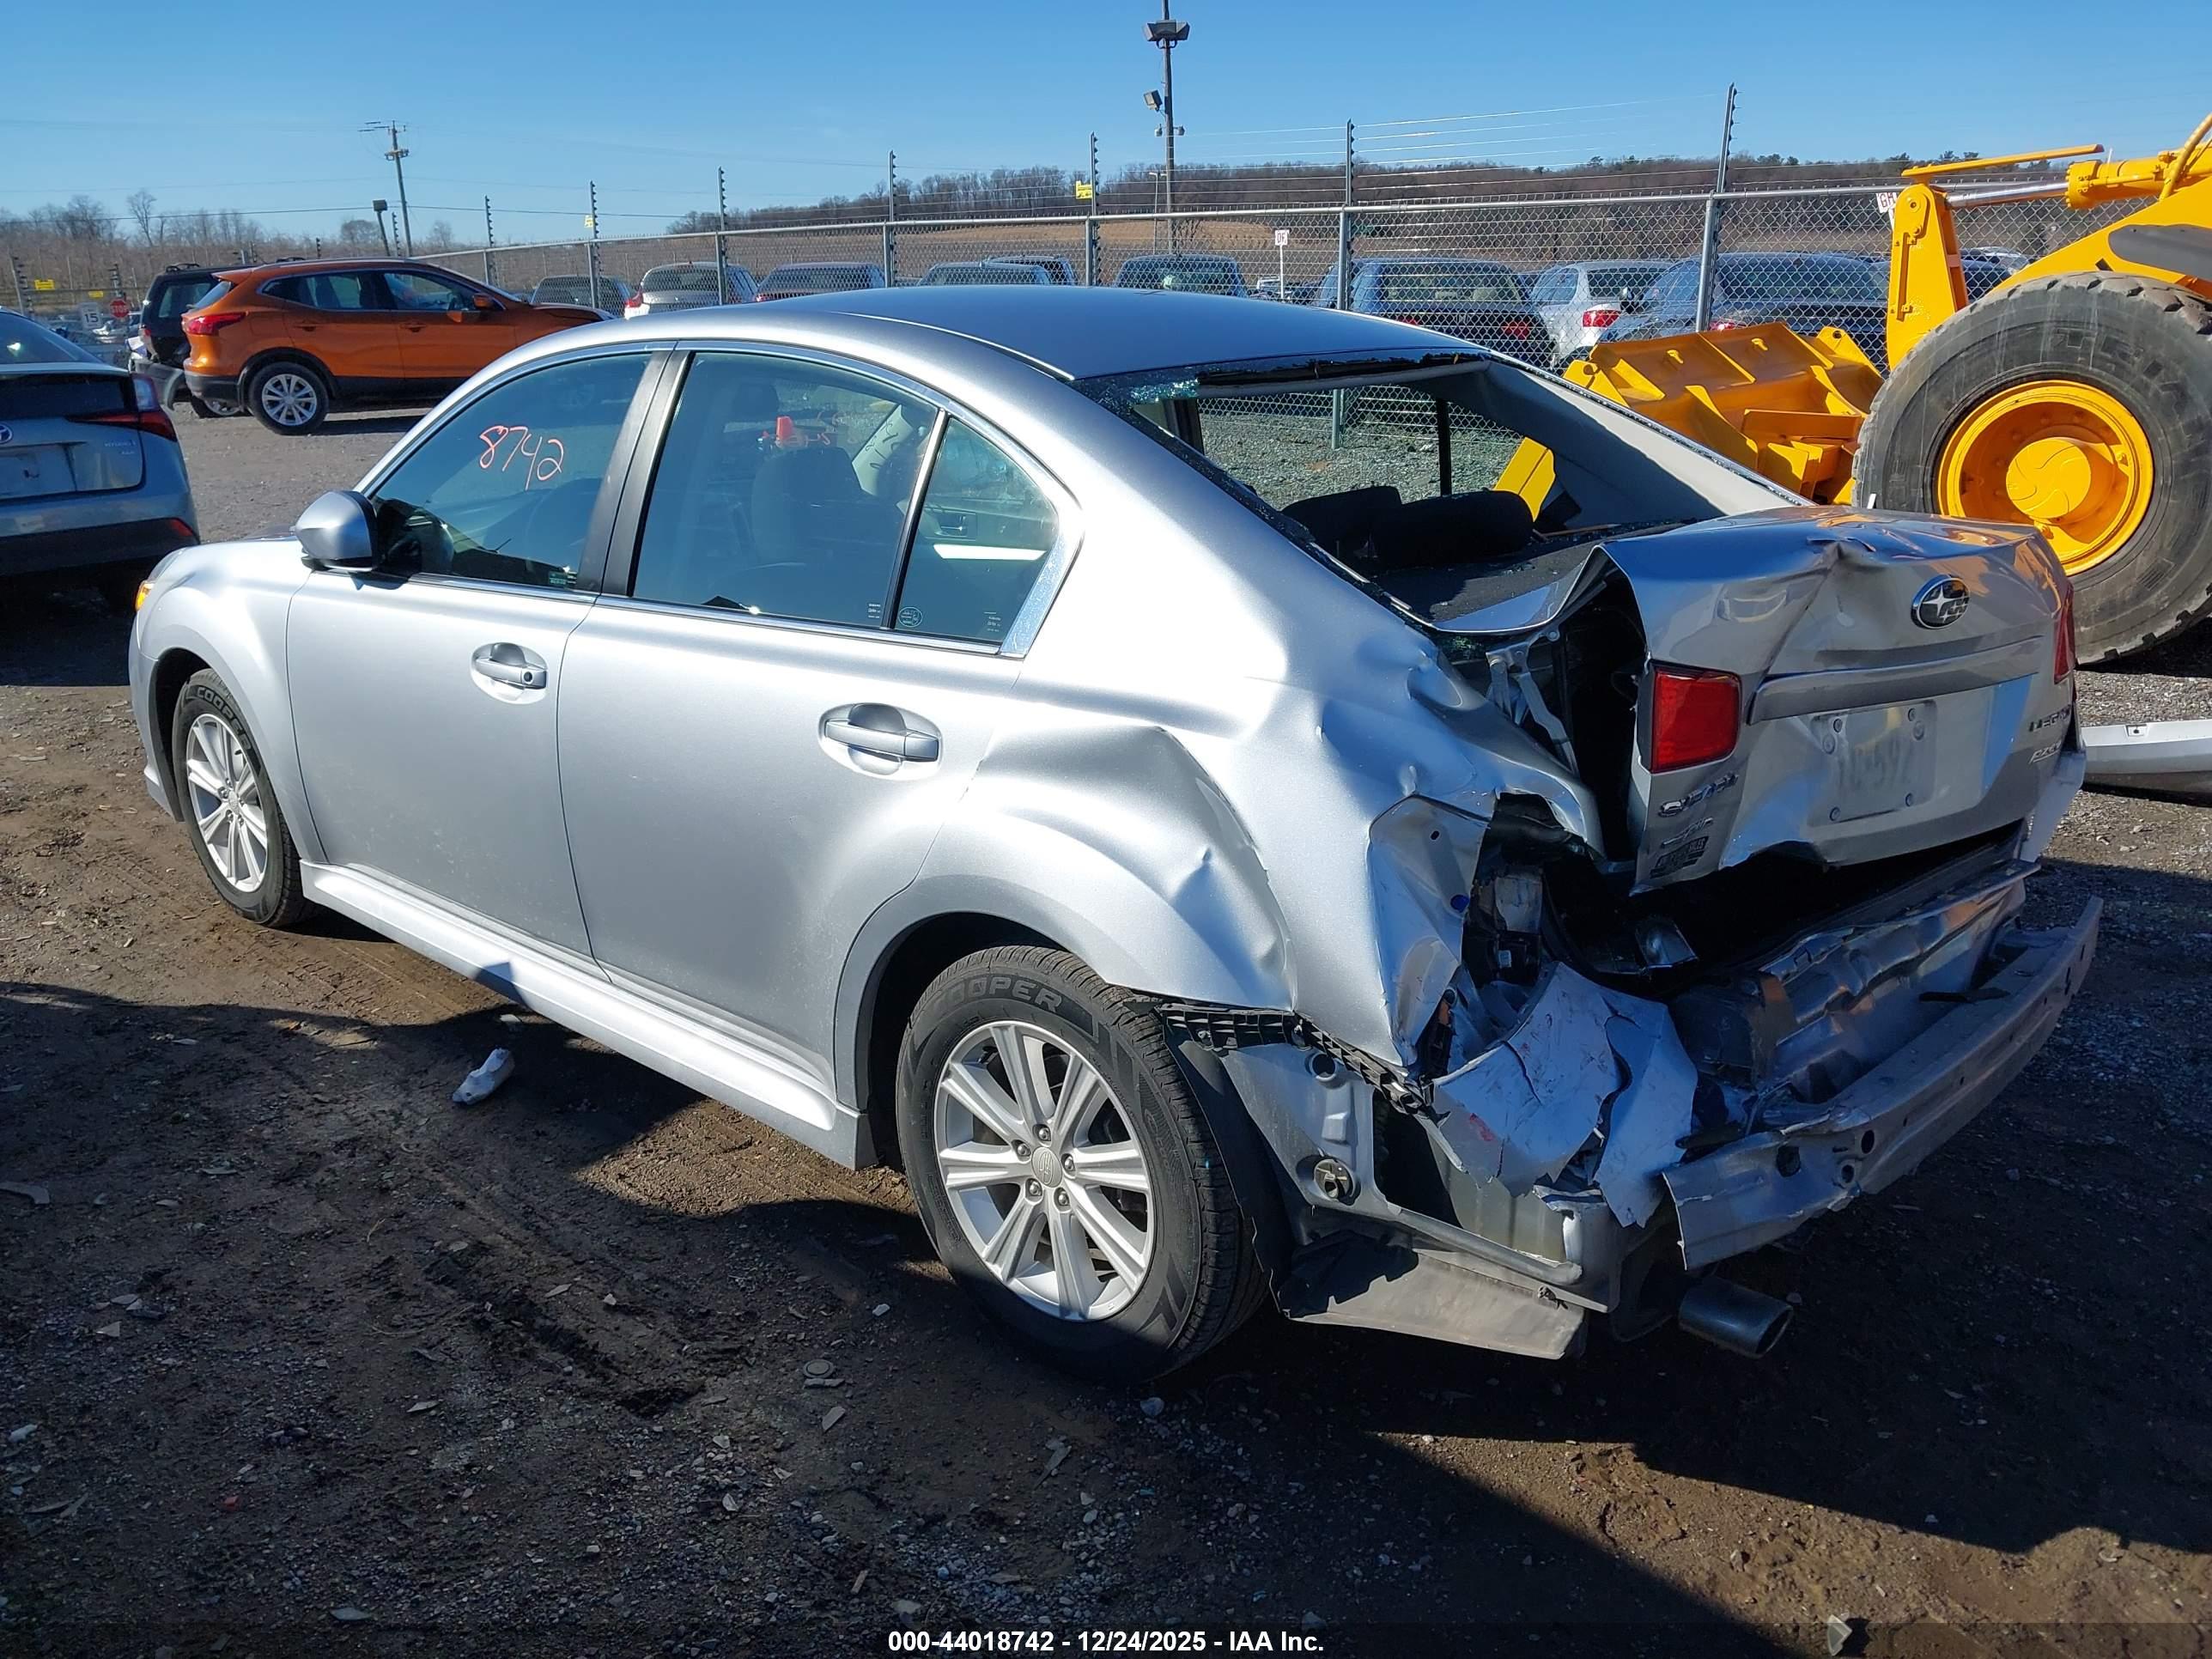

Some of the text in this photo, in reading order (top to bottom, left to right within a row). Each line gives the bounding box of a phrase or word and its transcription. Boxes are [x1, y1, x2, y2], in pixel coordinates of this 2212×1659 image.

[84, 313, 99, 323] 15
[479, 425, 564, 490] 8742
[197, 686, 252, 750] COOPER
